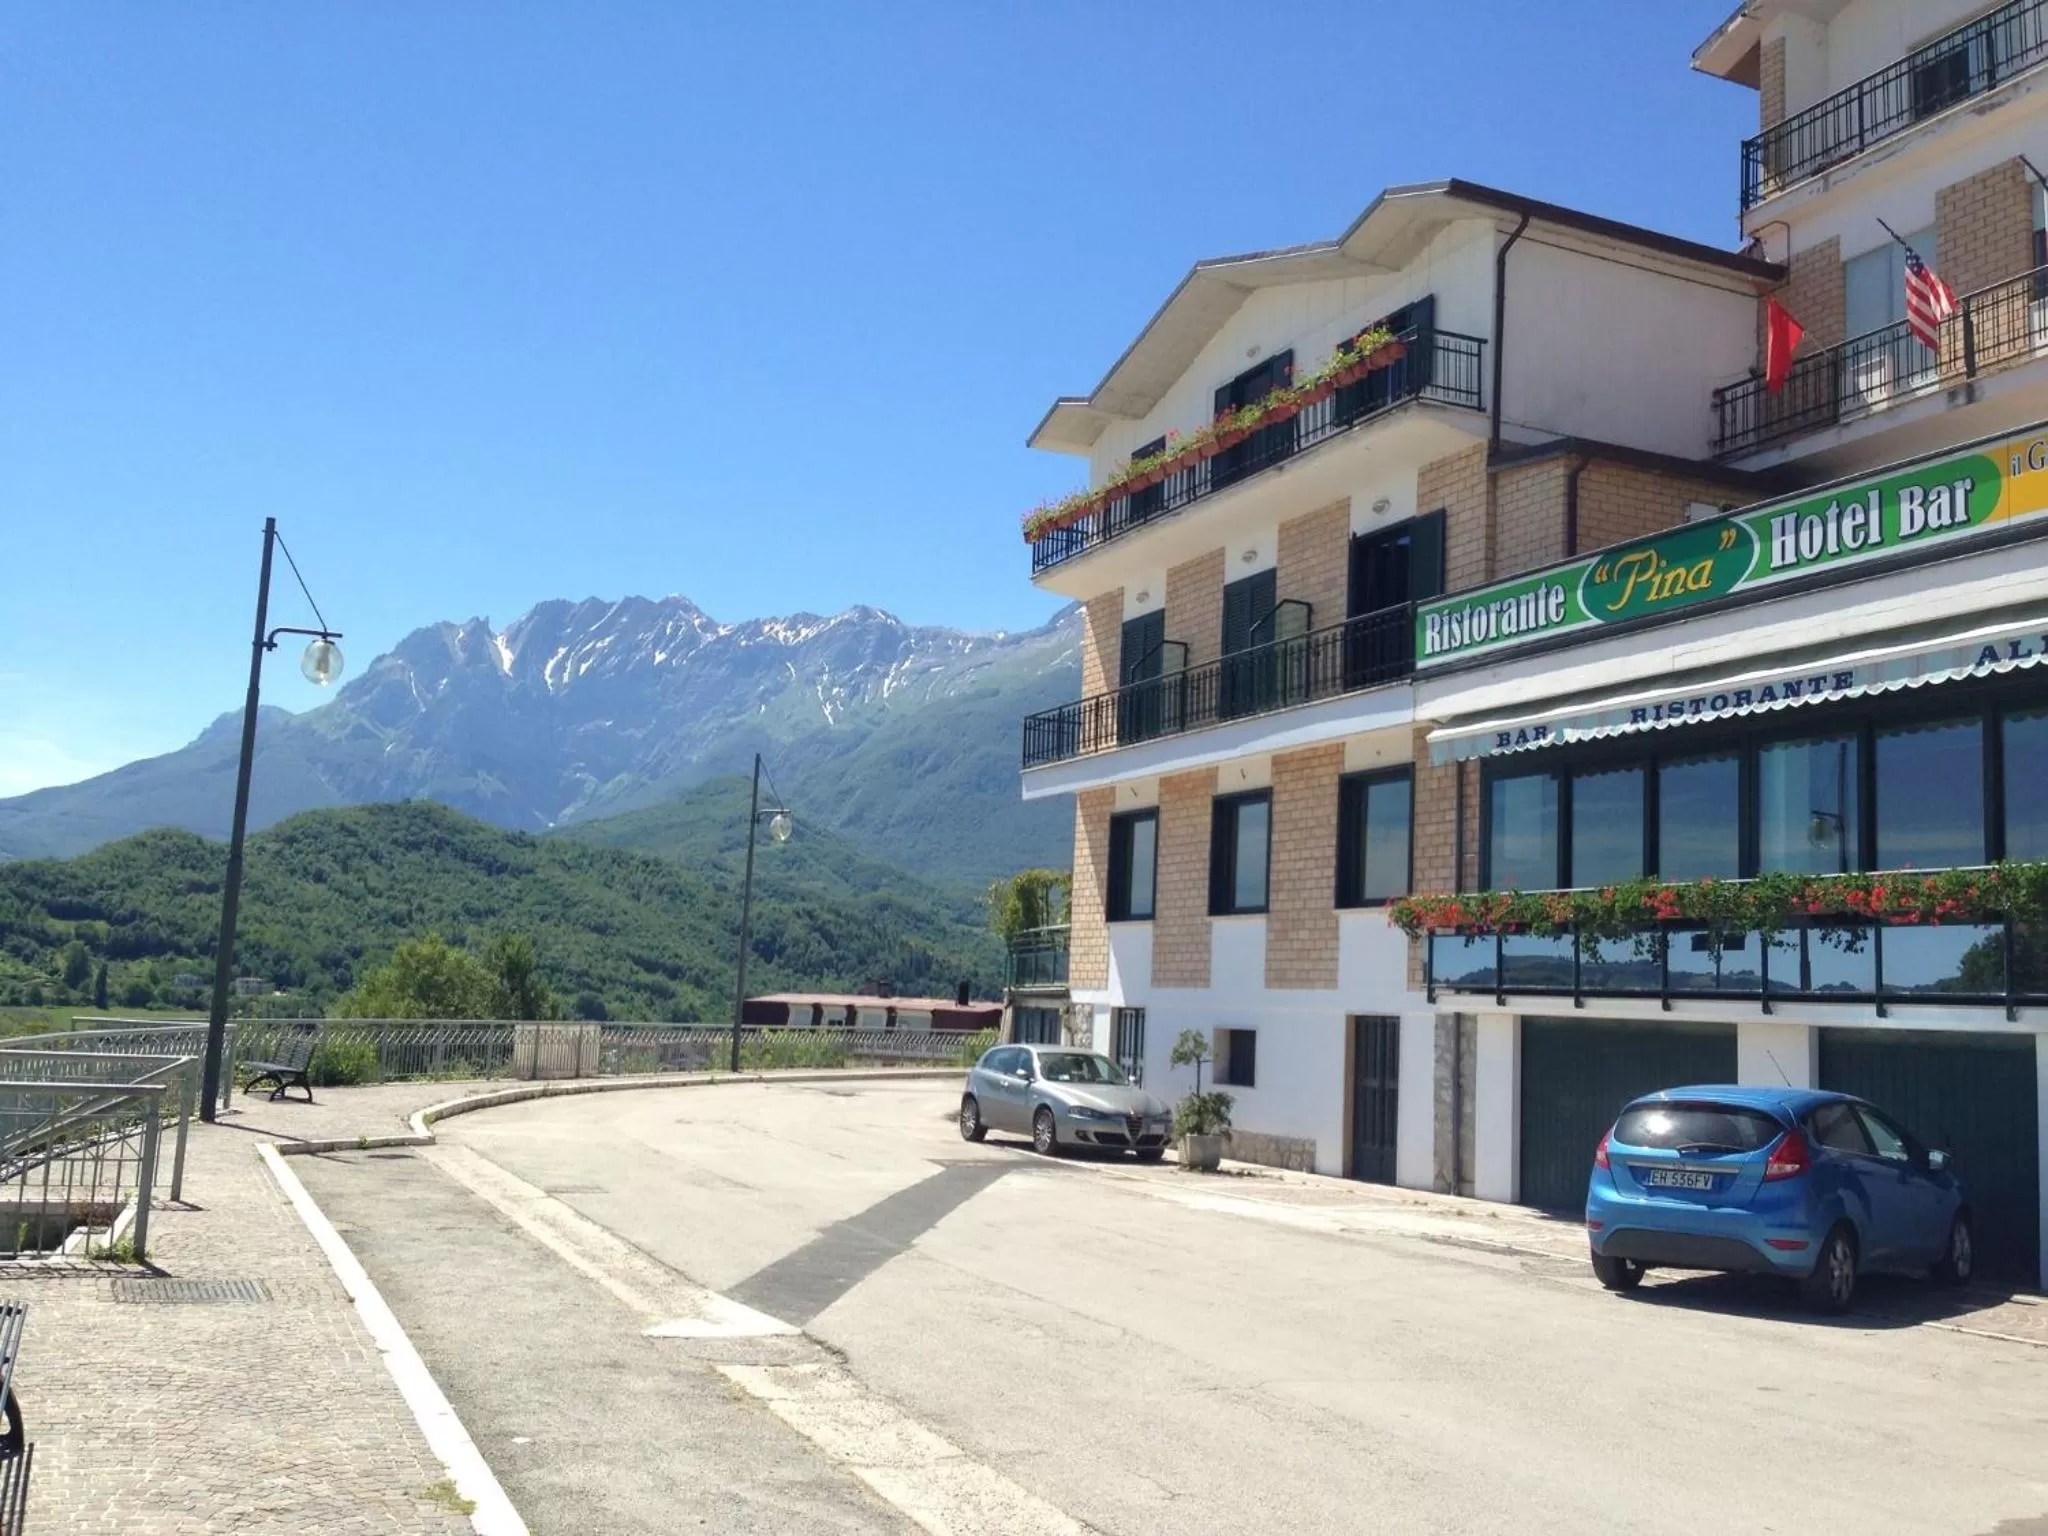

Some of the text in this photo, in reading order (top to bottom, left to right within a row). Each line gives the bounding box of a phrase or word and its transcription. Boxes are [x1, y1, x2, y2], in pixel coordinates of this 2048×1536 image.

[2028, 440, 2048, 471] G
[1424, 581, 1566, 655] Ristorante
[1770, 489, 1882, 569] Hotel
[1898, 477, 1975, 538] Bar
[1496, 725, 1548, 748] BAR
[1630, 671, 1854, 724] RISTORANTE
